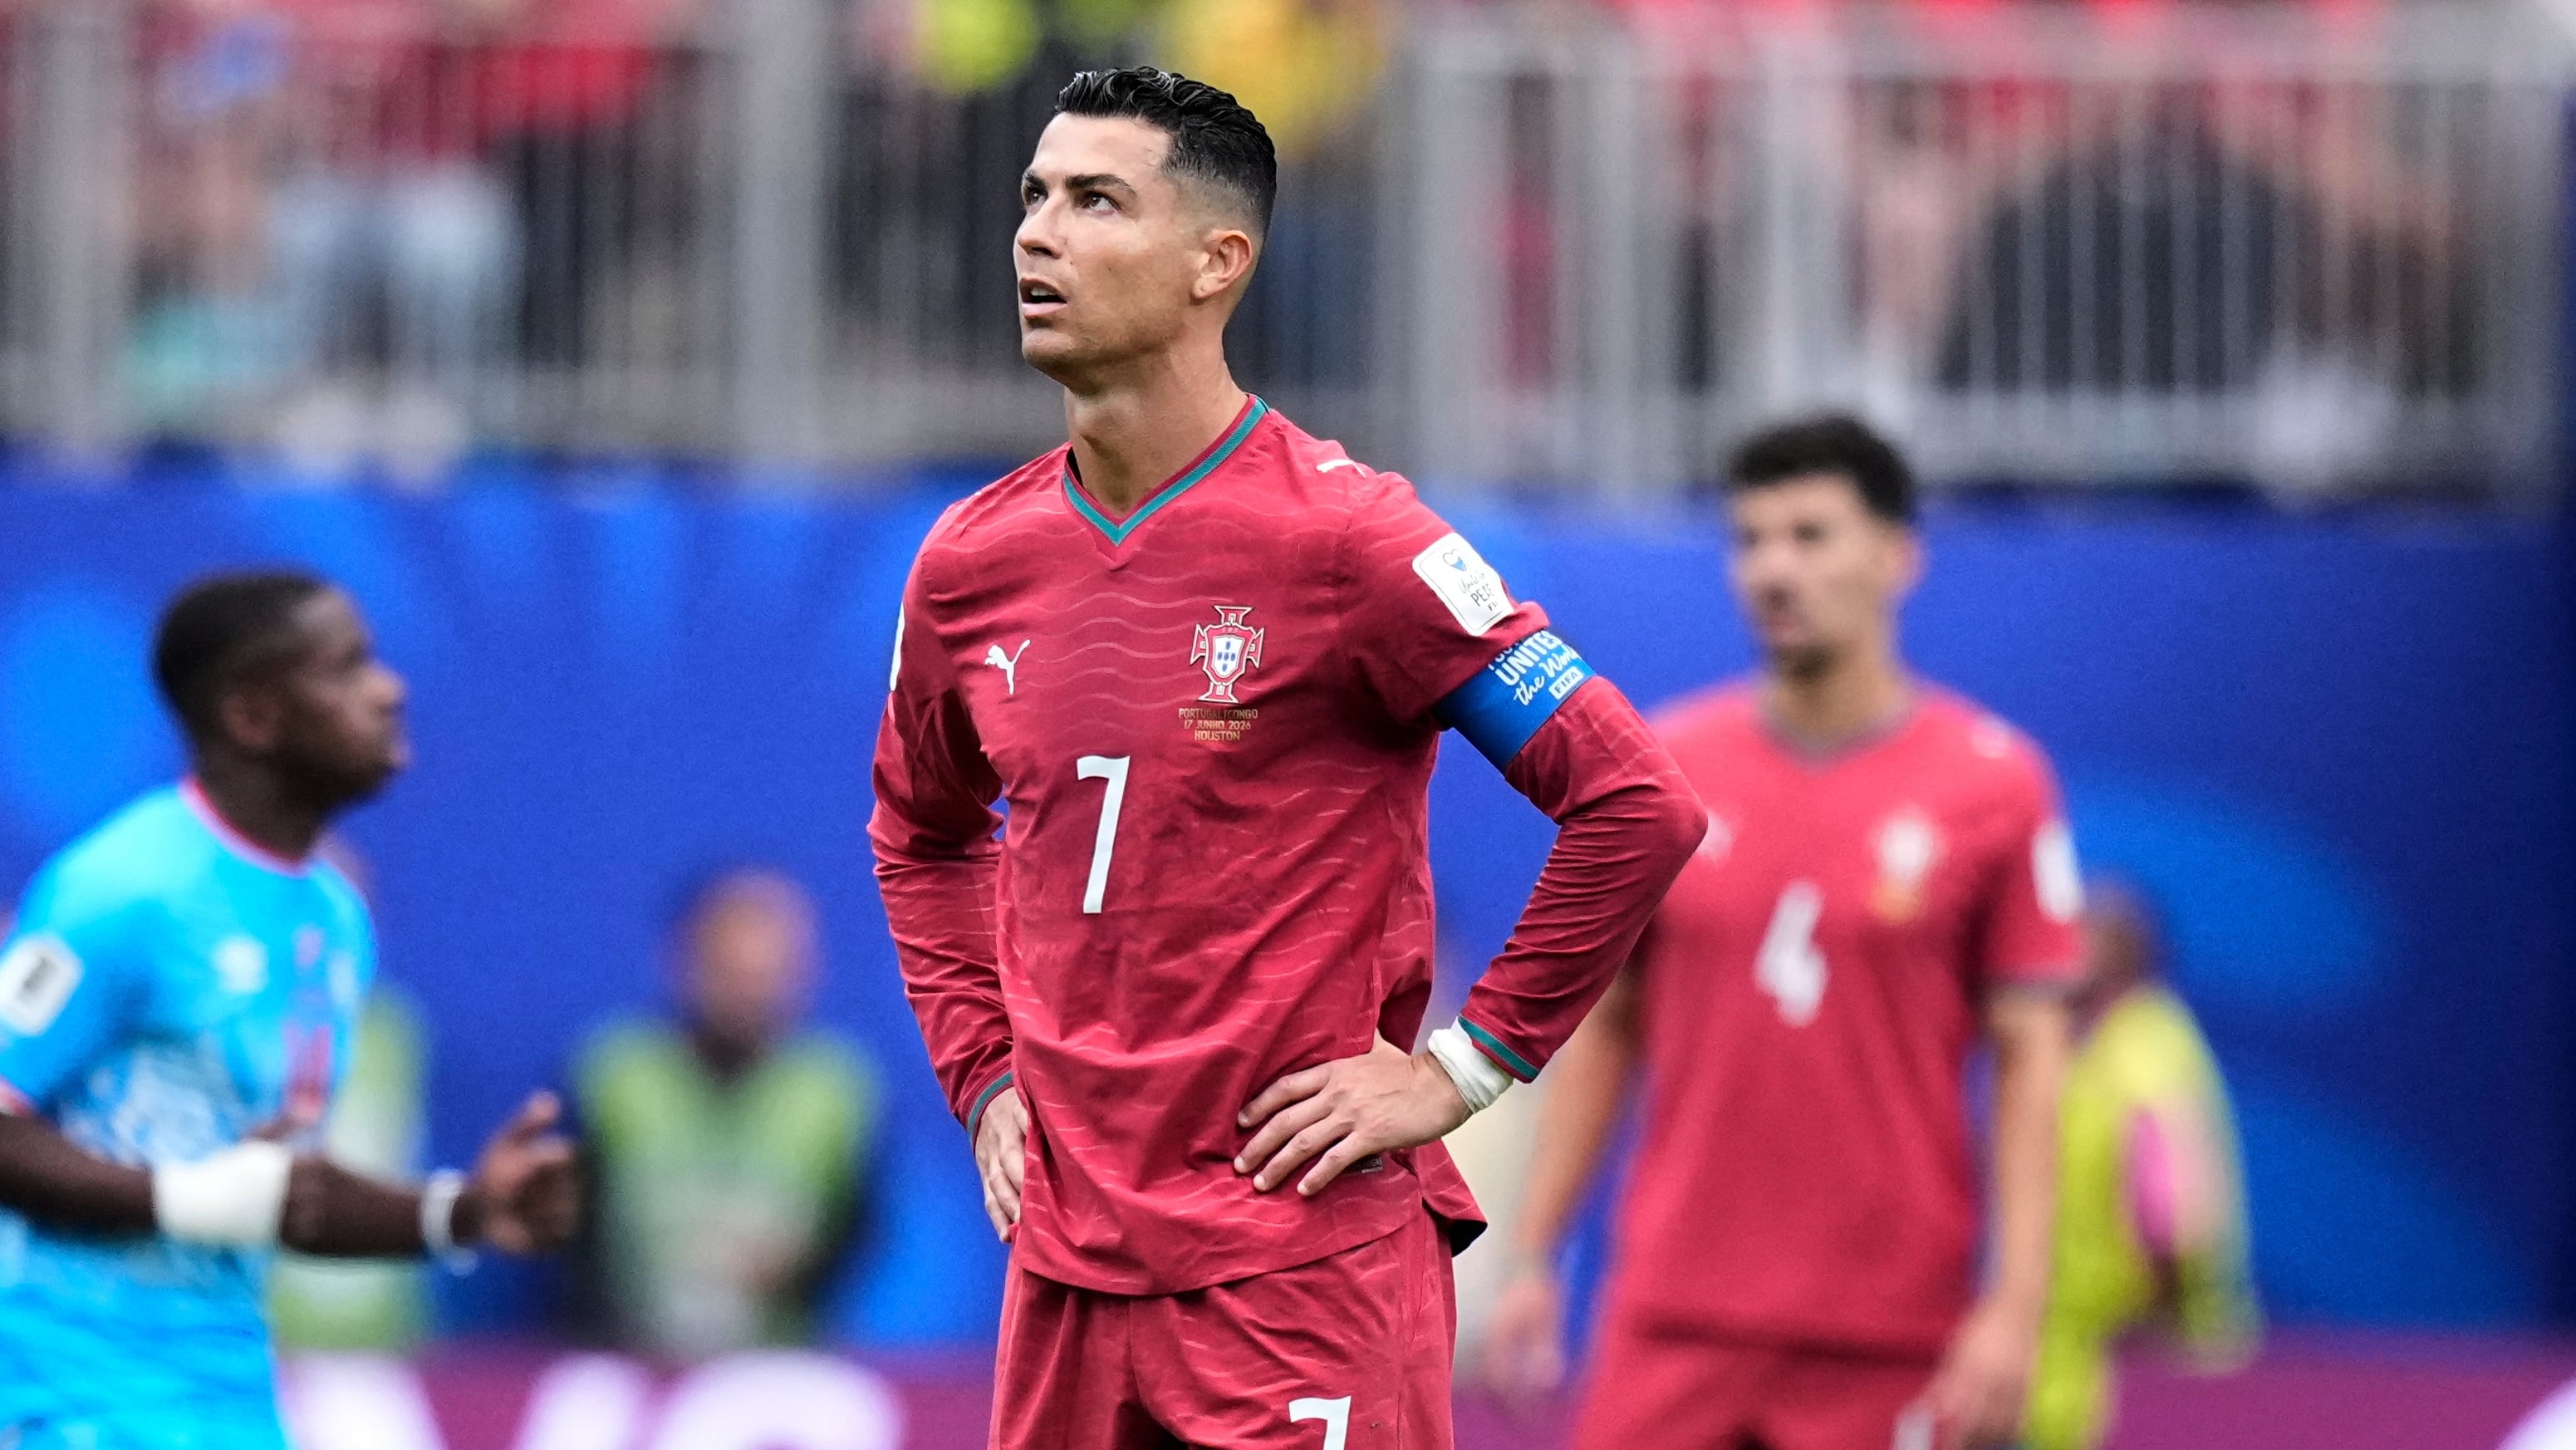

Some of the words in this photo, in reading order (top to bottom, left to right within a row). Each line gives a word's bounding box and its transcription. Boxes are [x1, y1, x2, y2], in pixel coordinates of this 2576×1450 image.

[1495, 630, 1563, 686] UNITES
[1513, 676, 1545, 705] the
[1554, 670, 1579, 695] FIFA
[1178, 707, 1259, 720] PORTUGAL/CONGO
[1184, 720, 1194, 730] 17
[1196, 720, 1225, 730] JUNHO
[1229, 720, 1252, 730] 2026
[1194, 730, 1241, 741] HOUSTON
[1077, 755, 1131, 913] 7
[1754, 879, 1828, 1029] 4
